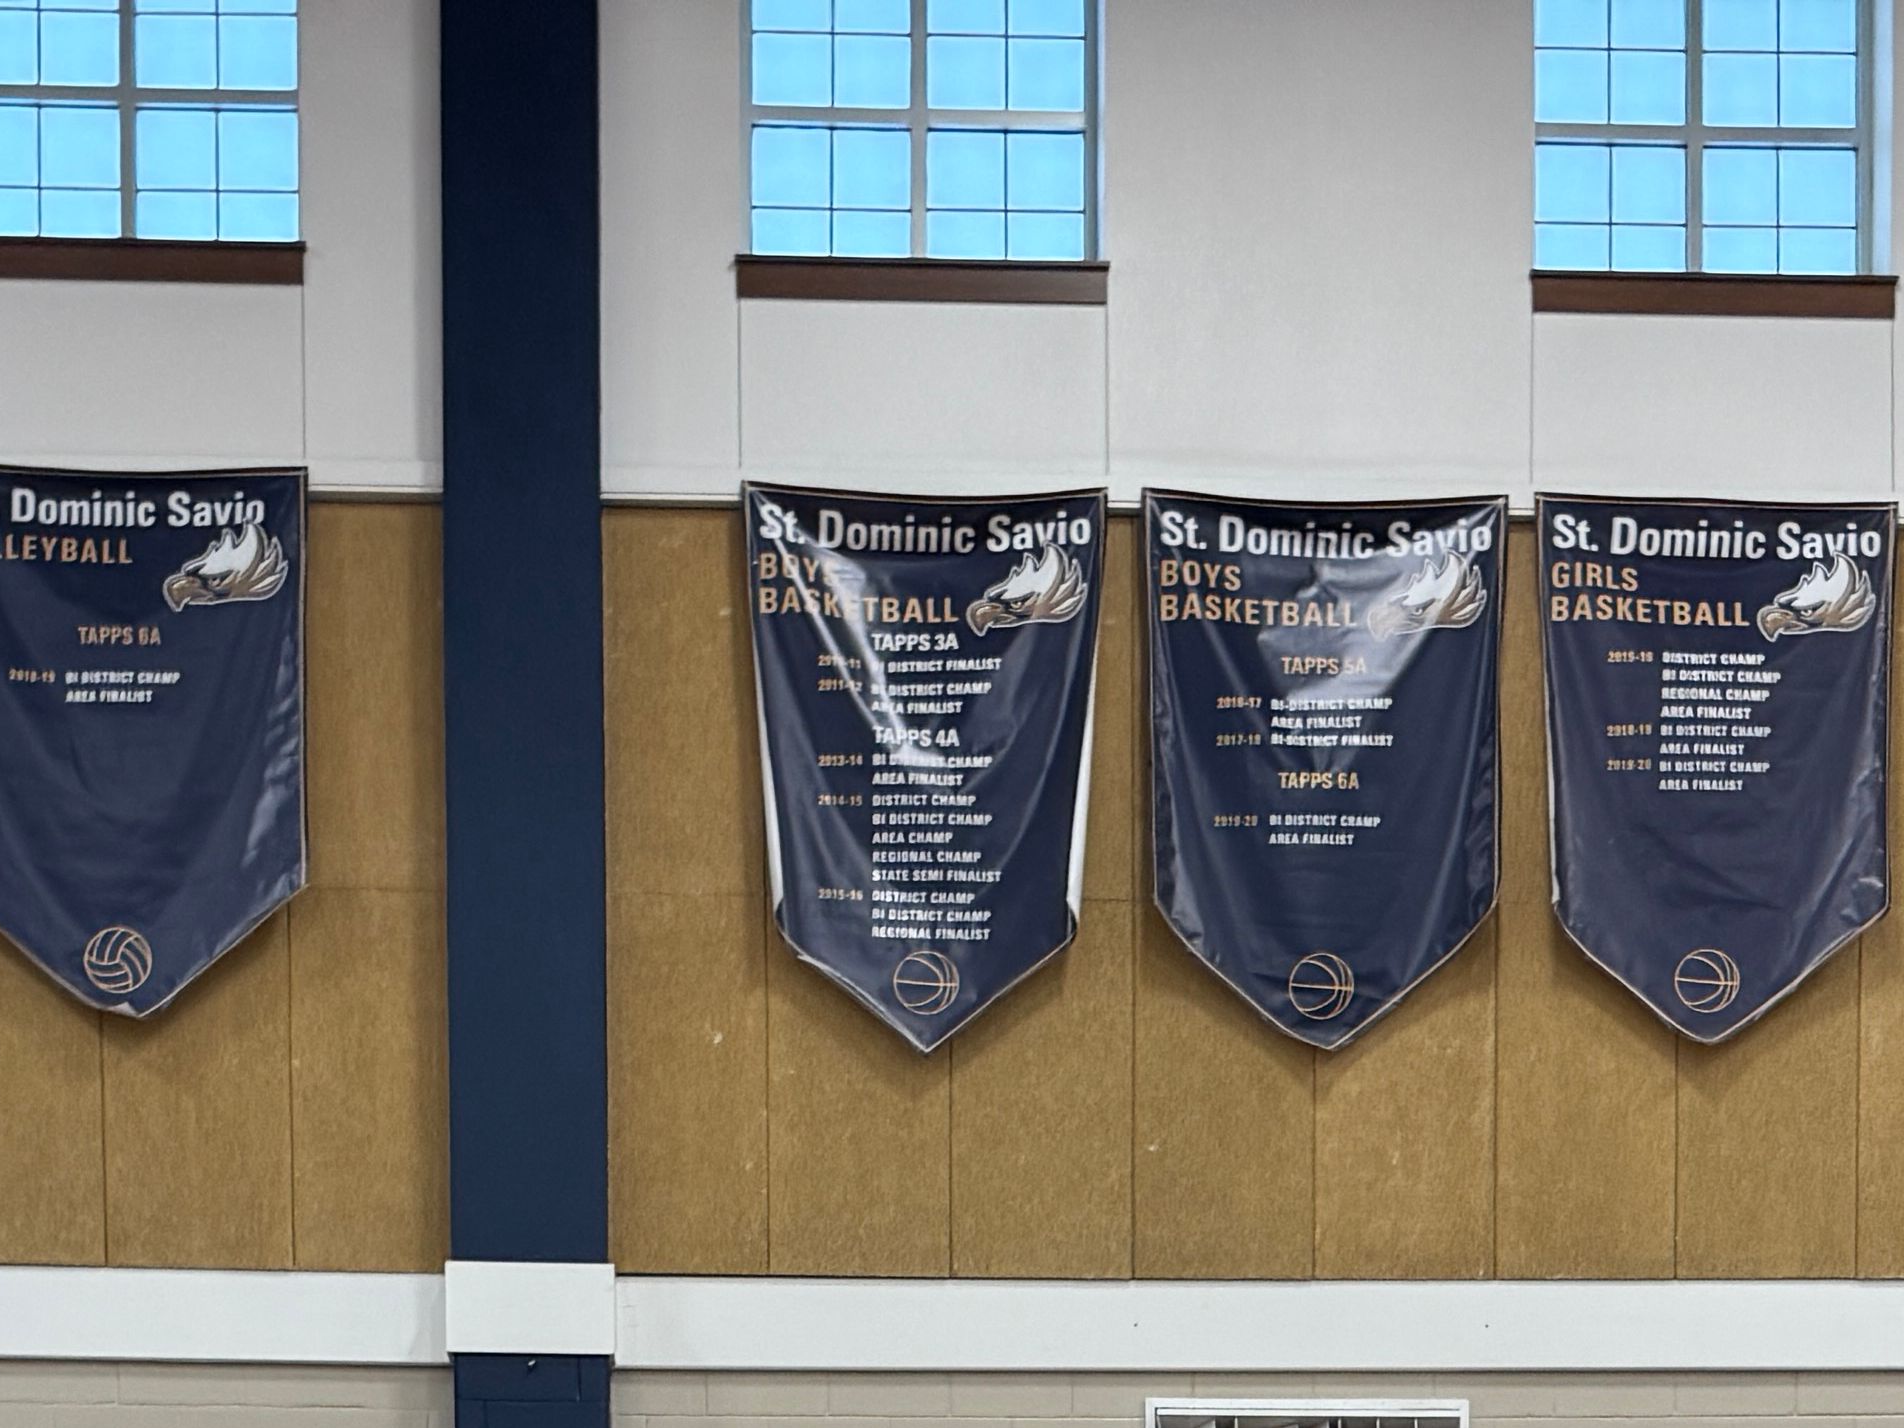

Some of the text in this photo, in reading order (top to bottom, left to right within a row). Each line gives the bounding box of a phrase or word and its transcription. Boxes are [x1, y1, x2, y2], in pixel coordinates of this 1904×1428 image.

[10, 488, 156, 527] Dominic
[168, 490, 264, 528] Savio
[759, 503, 1092, 554] St. Dominic Savio
[1160, 511, 1492, 560] St. Dominic Savio
[1552, 514, 1881, 560] St. Dominic Savio
[1160, 560, 1241, 591] BOYS
[1551, 561, 1639, 592] GIRLS
[1160, 594, 1357, 628] BASKETBALL
[1551, 595, 1750, 628] BASKETBALL
[78, 627, 133, 645] TAPPS
[872, 633, 959, 651] TAPPS 3A
[1281, 657, 1339, 675] TAPPS
[872, 726, 959, 747] TAPPS 4A
[872, 772, 964, 786] AREA FINALIST
[1278, 772, 1359, 789] TAPPS 6A
[872, 814, 992, 826] BI DISTRICT CHAMP
[872, 833, 953, 844] AREA CHAMP
[872, 852, 981, 863] REGIONAL CHAMP
[872, 870, 1001, 882] STATE SEMI FINALIST
[888, 910, 943, 921] DISTRICT
[947, 911, 991, 922] CHAMP
[935, 928, 990, 940] FINALIST
